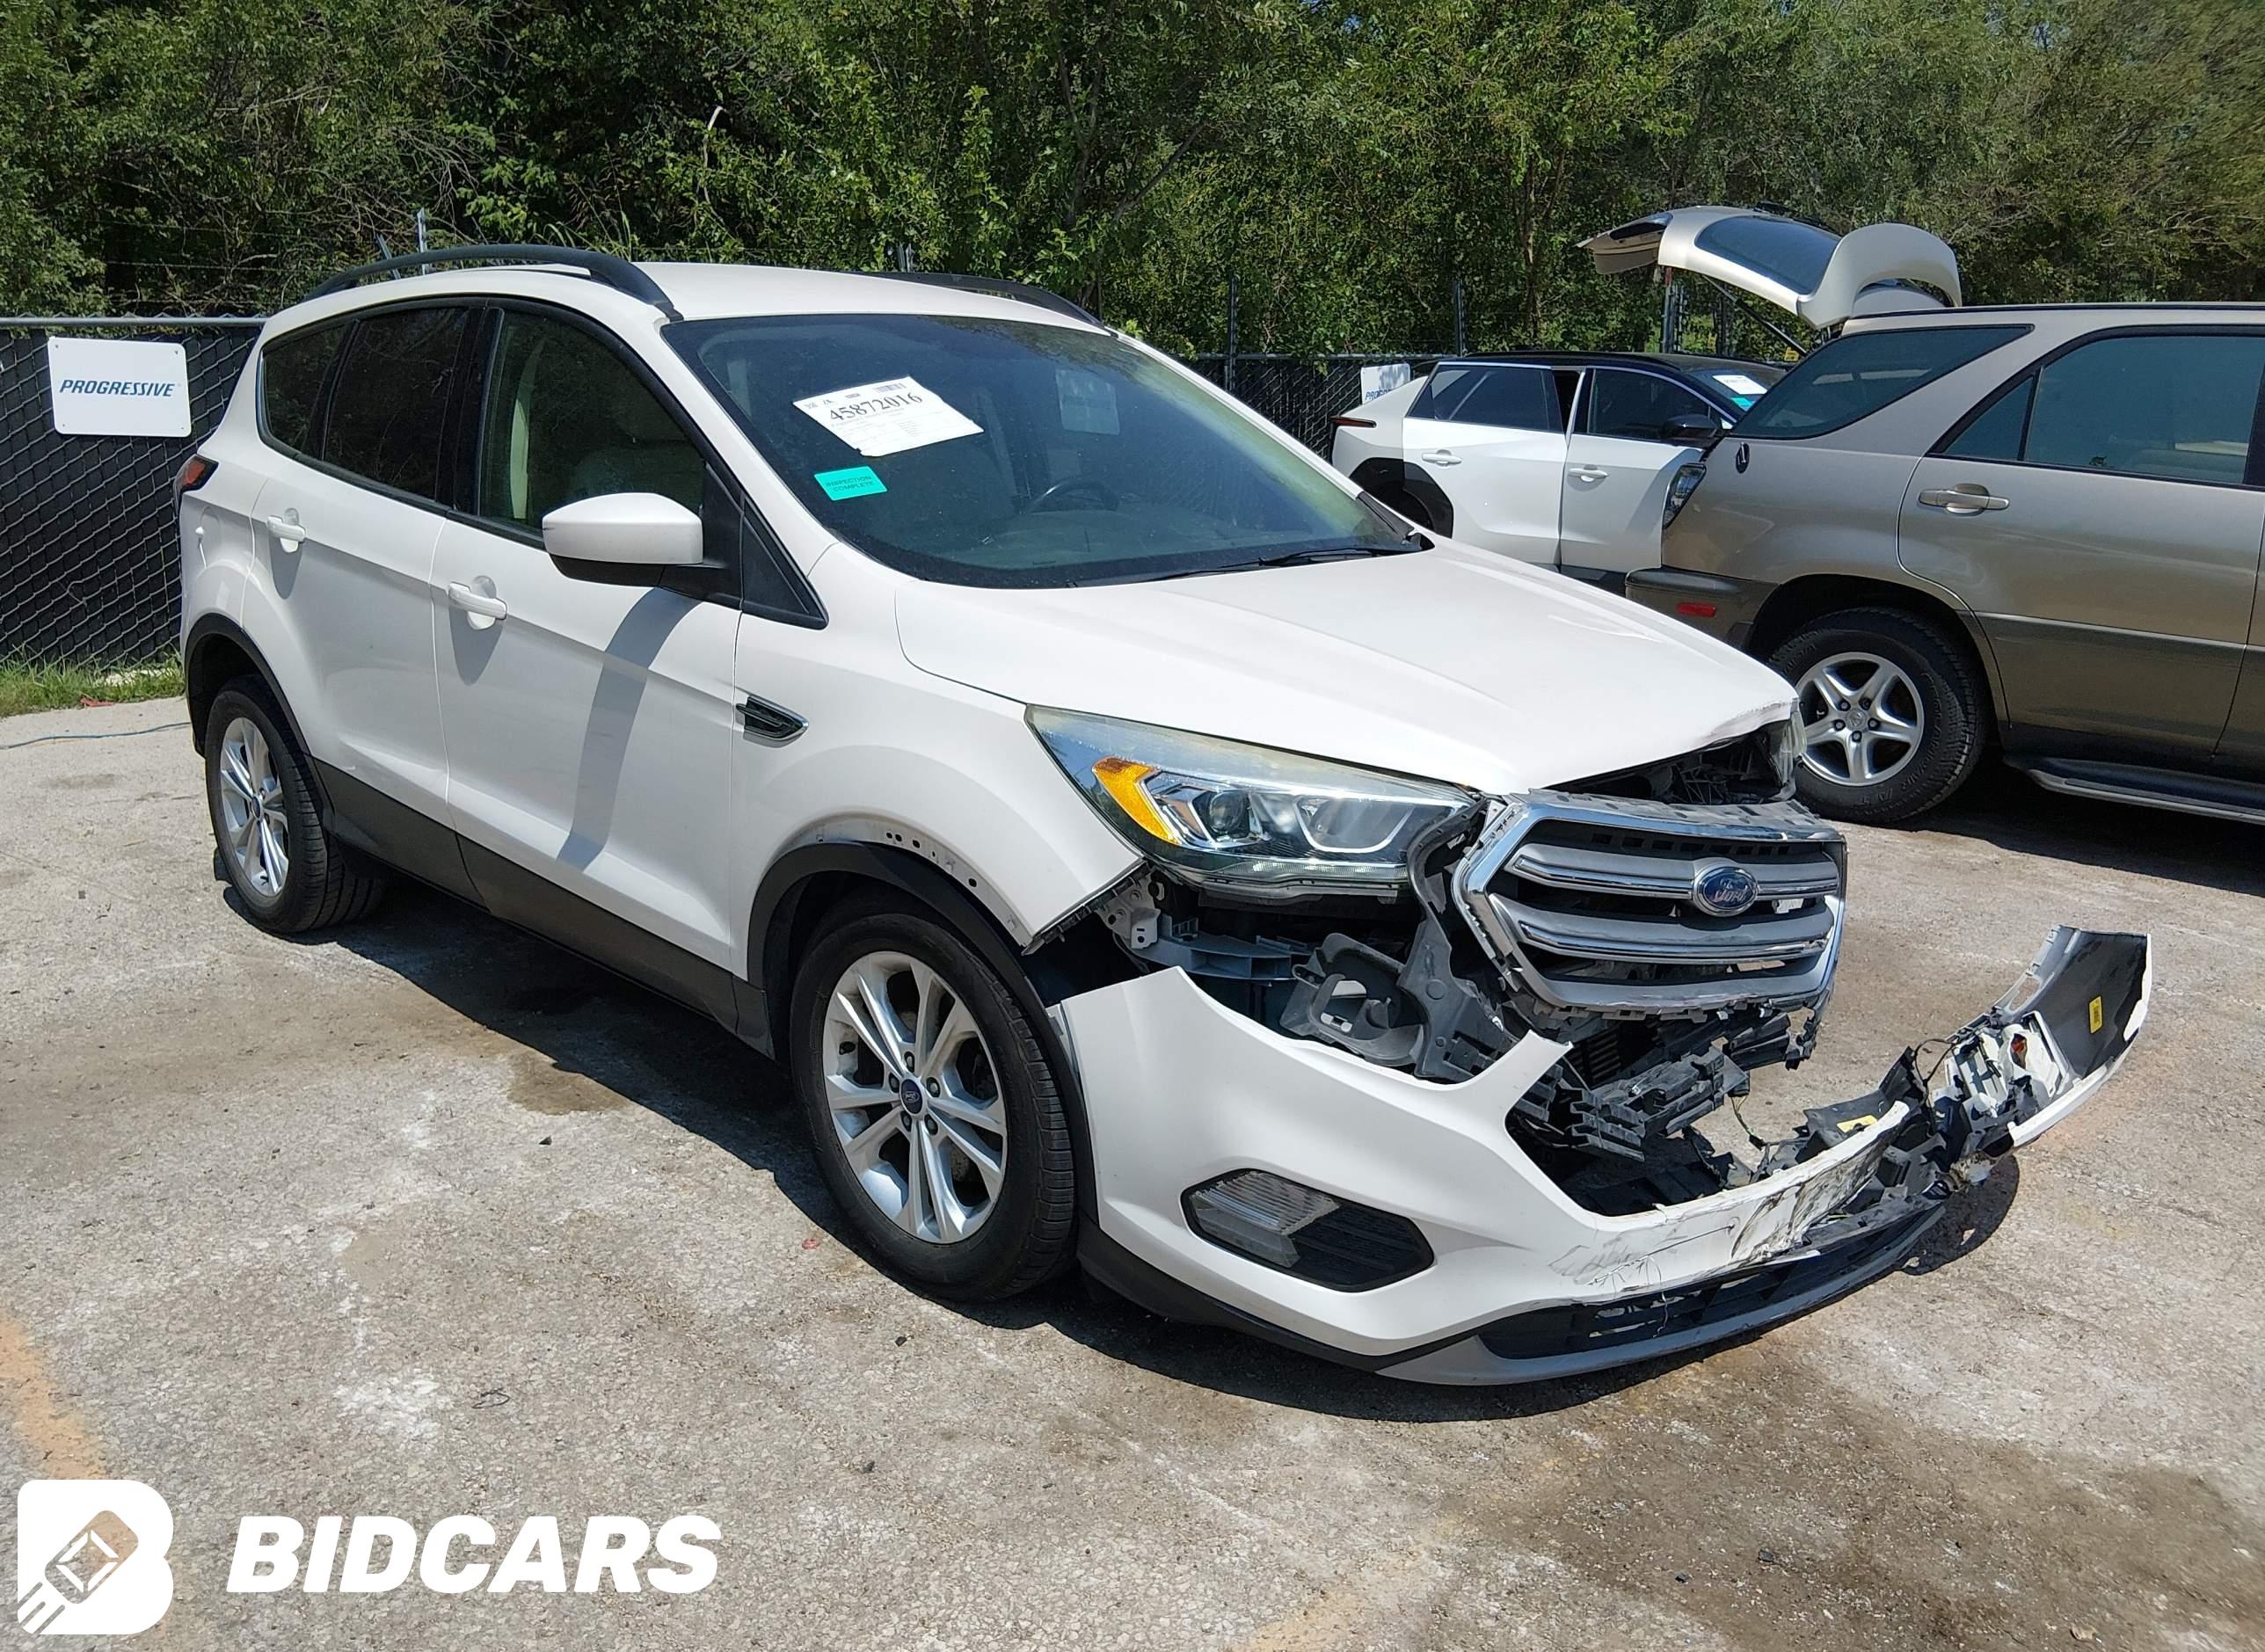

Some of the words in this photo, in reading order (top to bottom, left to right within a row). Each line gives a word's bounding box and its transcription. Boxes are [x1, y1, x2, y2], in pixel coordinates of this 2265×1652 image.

[60, 379, 175, 397] PROGRESSIVE
[830, 392, 923, 421] 45872016
[826, 476, 873, 487] INSPECTION
[833, 481, 874, 492] COMPLETE
